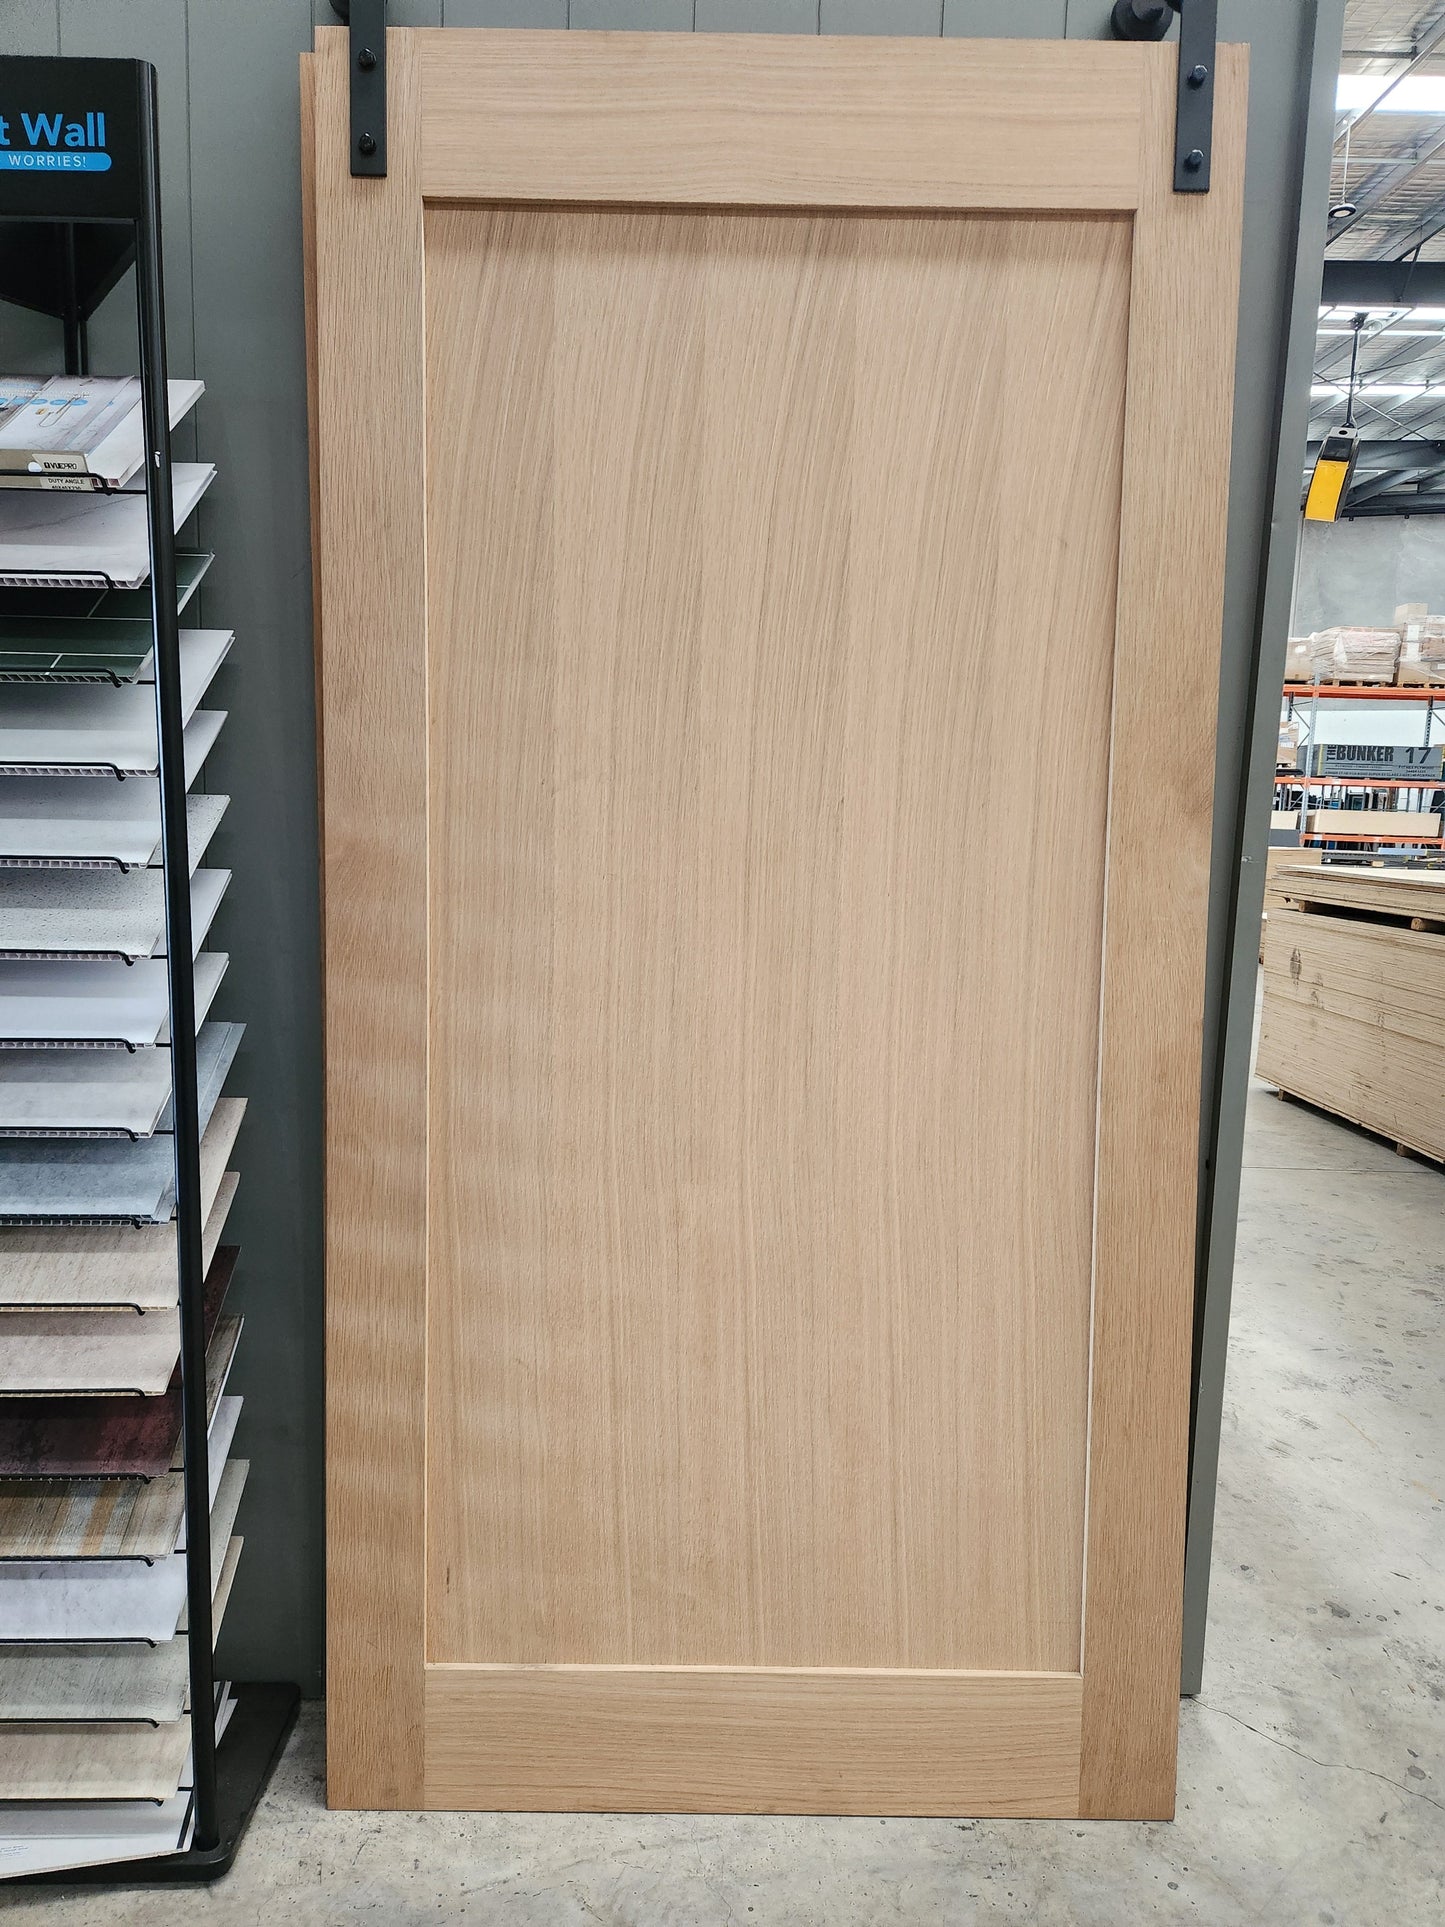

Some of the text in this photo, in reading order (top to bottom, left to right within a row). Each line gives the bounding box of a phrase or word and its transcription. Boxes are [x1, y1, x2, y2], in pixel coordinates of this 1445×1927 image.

[20, 112, 105, 147] Wall
[8, 155, 87, 168] WORRIES!
[1326, 744, 1394, 762] THE BUNKER
[1405, 746, 1432, 764] 17
